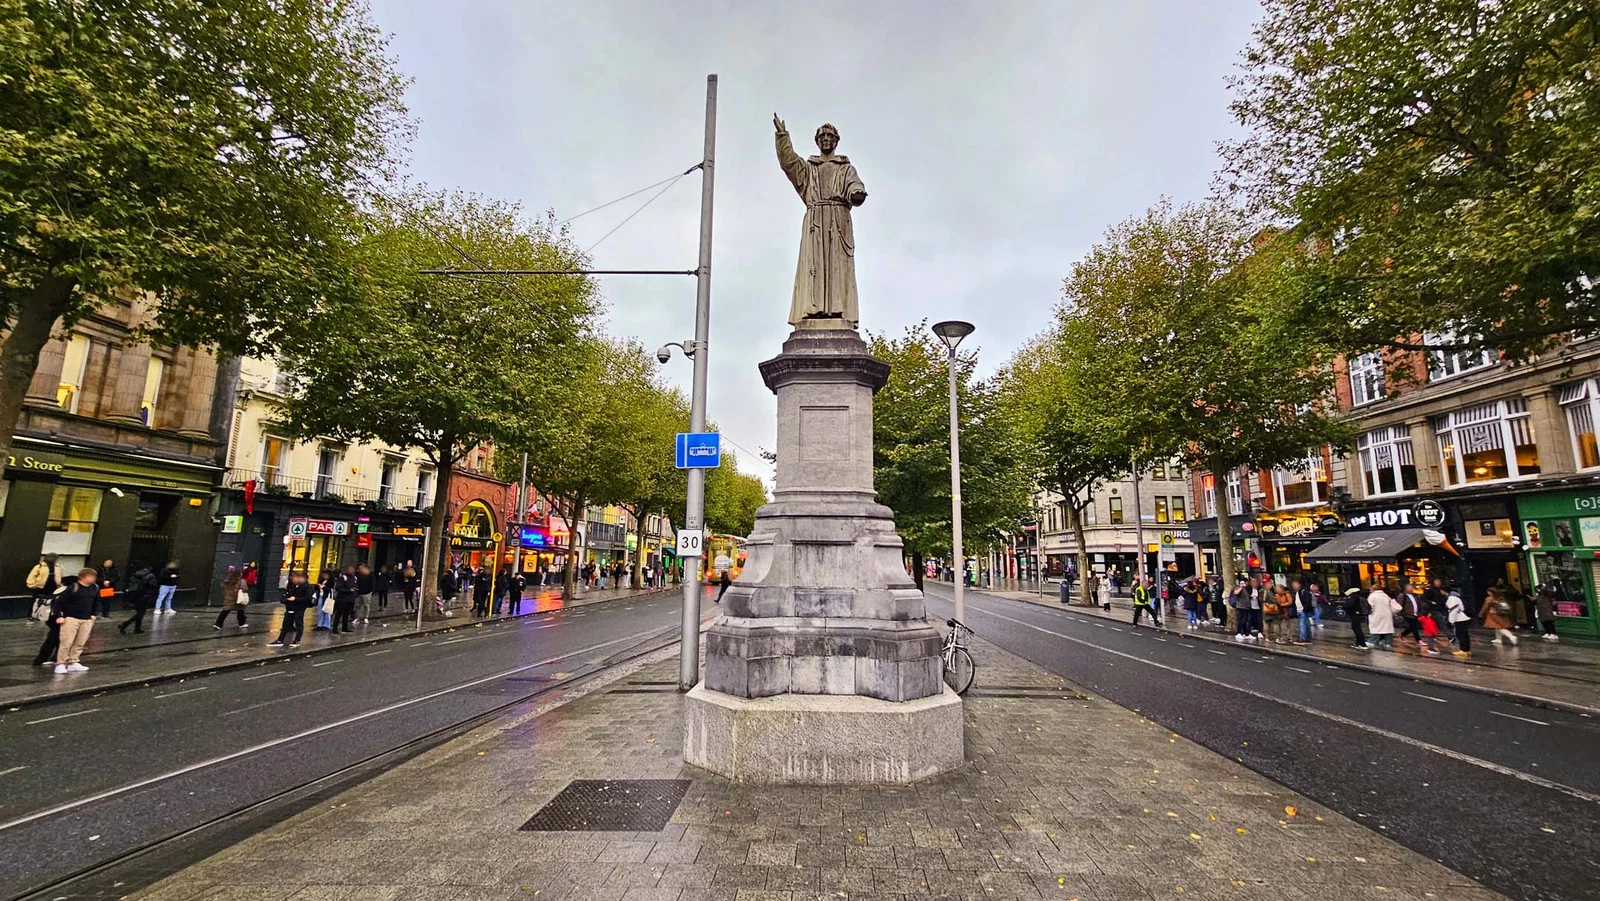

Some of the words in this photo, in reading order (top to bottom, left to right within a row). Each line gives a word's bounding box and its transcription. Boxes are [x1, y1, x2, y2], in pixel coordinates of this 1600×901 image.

[23, 456, 62, 471] Store
[1574, 495, 1600, 511] [o]
[1351, 516, 1366, 527] the
[1368, 509, 1411, 526] HOT
[681, 536, 699, 549] 30
